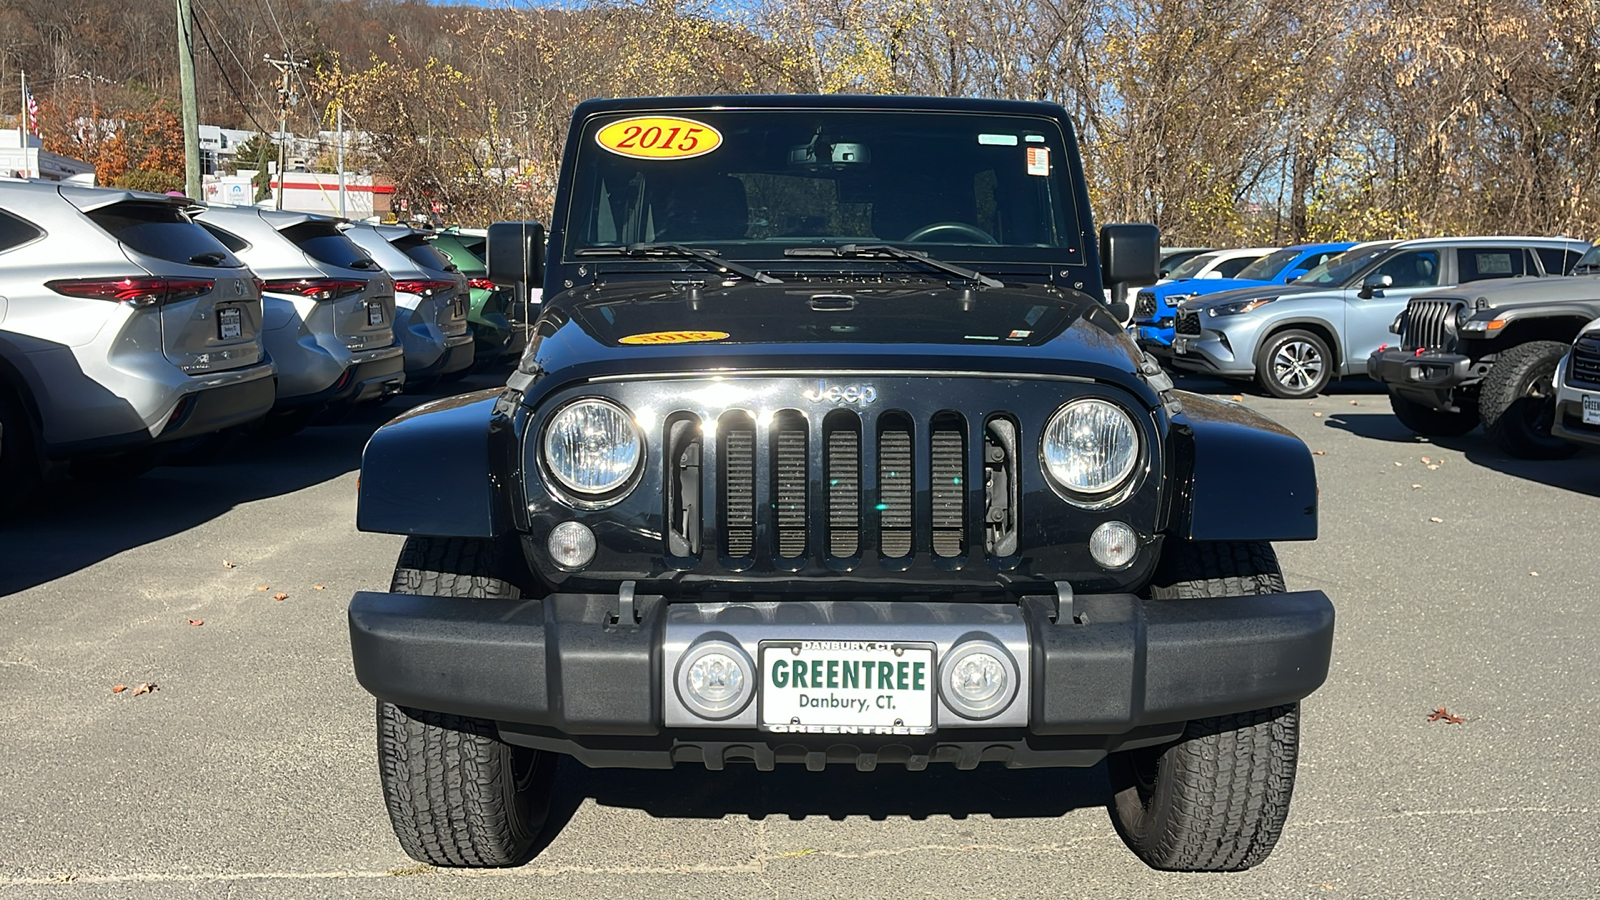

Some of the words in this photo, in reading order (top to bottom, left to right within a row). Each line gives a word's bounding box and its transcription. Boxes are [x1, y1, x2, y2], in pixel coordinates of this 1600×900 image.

[616, 126, 703, 151] 2015
[803, 379, 877, 407] Jeep
[802, 641, 872, 651] DANBURY,
[875, 642, 894, 651] CT
[772, 659, 925, 690] GREENTREE
[799, 693, 870, 713] Danbury,
[876, 695, 896, 709] CT.
[769, 724, 926, 735] GREENTREE
